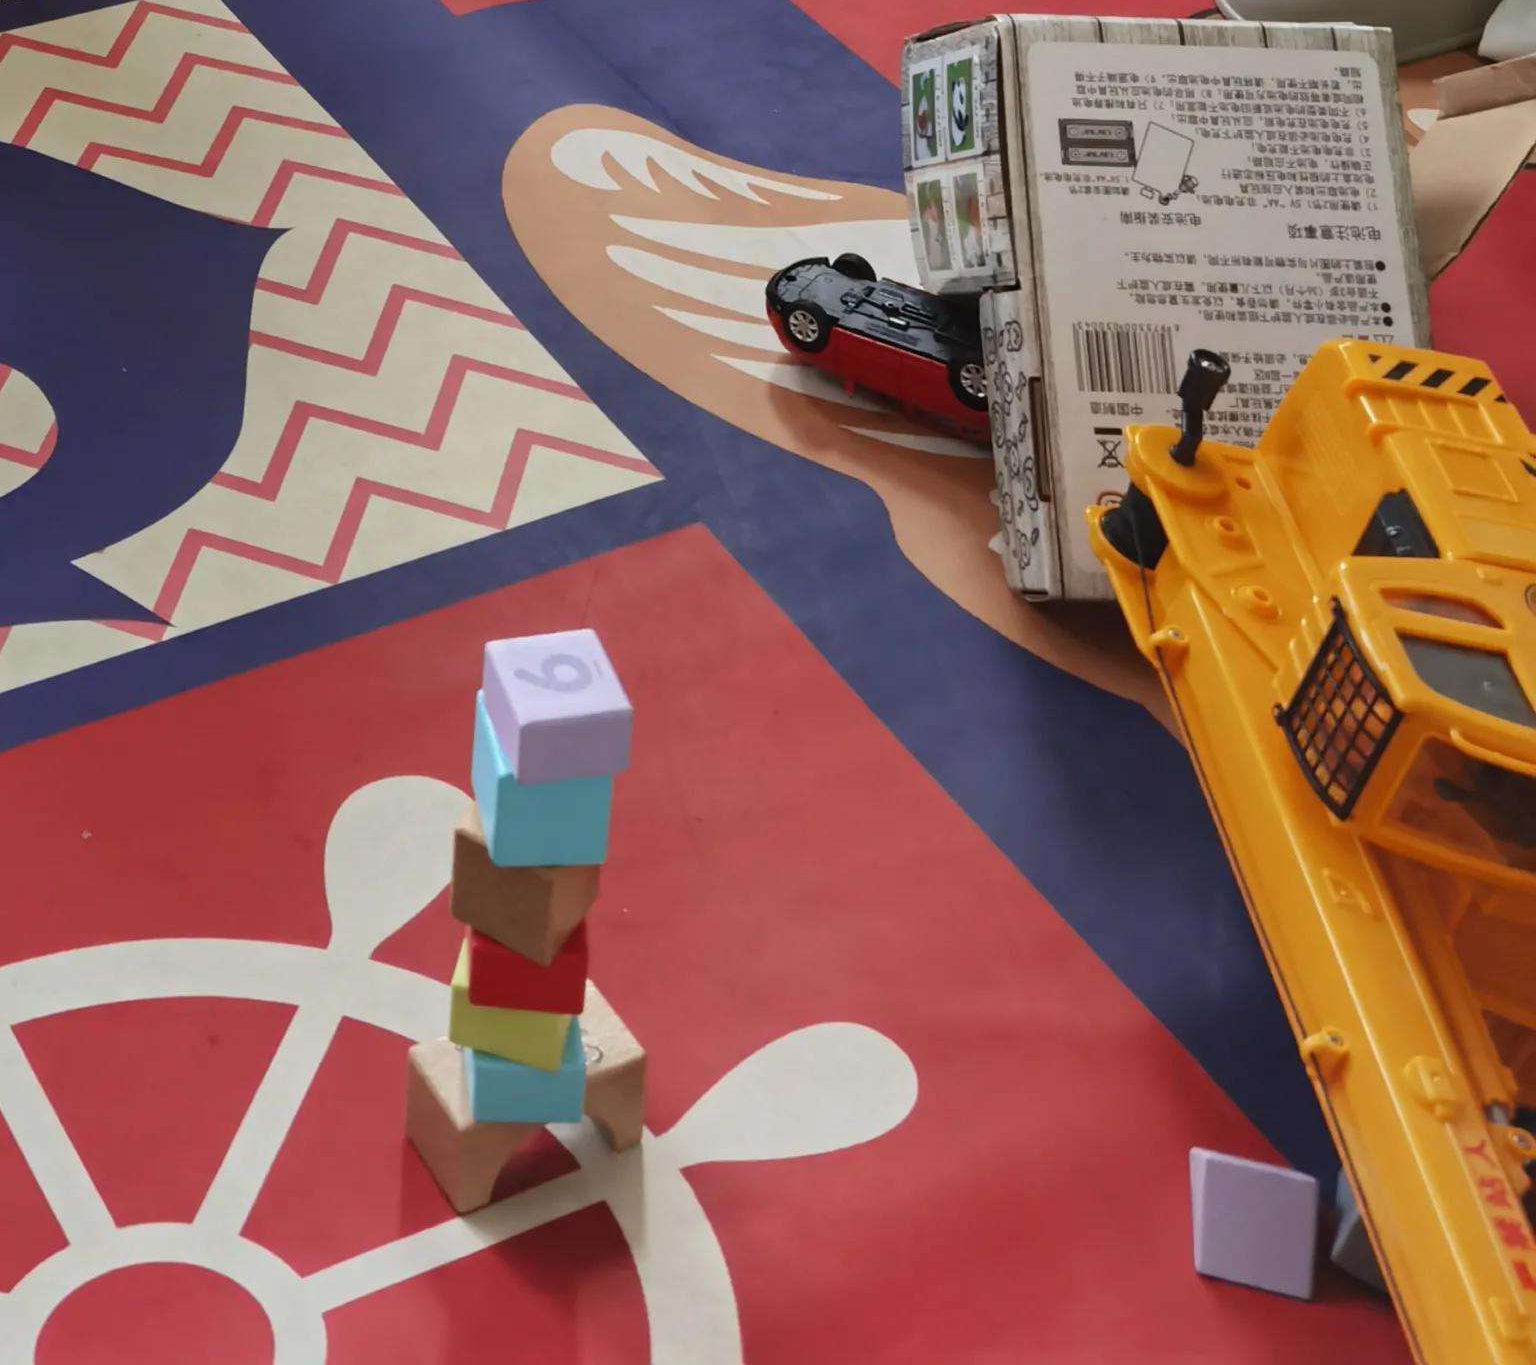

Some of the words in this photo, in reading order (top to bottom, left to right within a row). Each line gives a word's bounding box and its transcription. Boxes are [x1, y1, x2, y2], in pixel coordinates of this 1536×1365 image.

[1120, 211, 1202, 226] 电池安装指南
[1286, 224, 1382, 241] 电池注意事项
[1090, 401, 1144, 417] 中国制造
